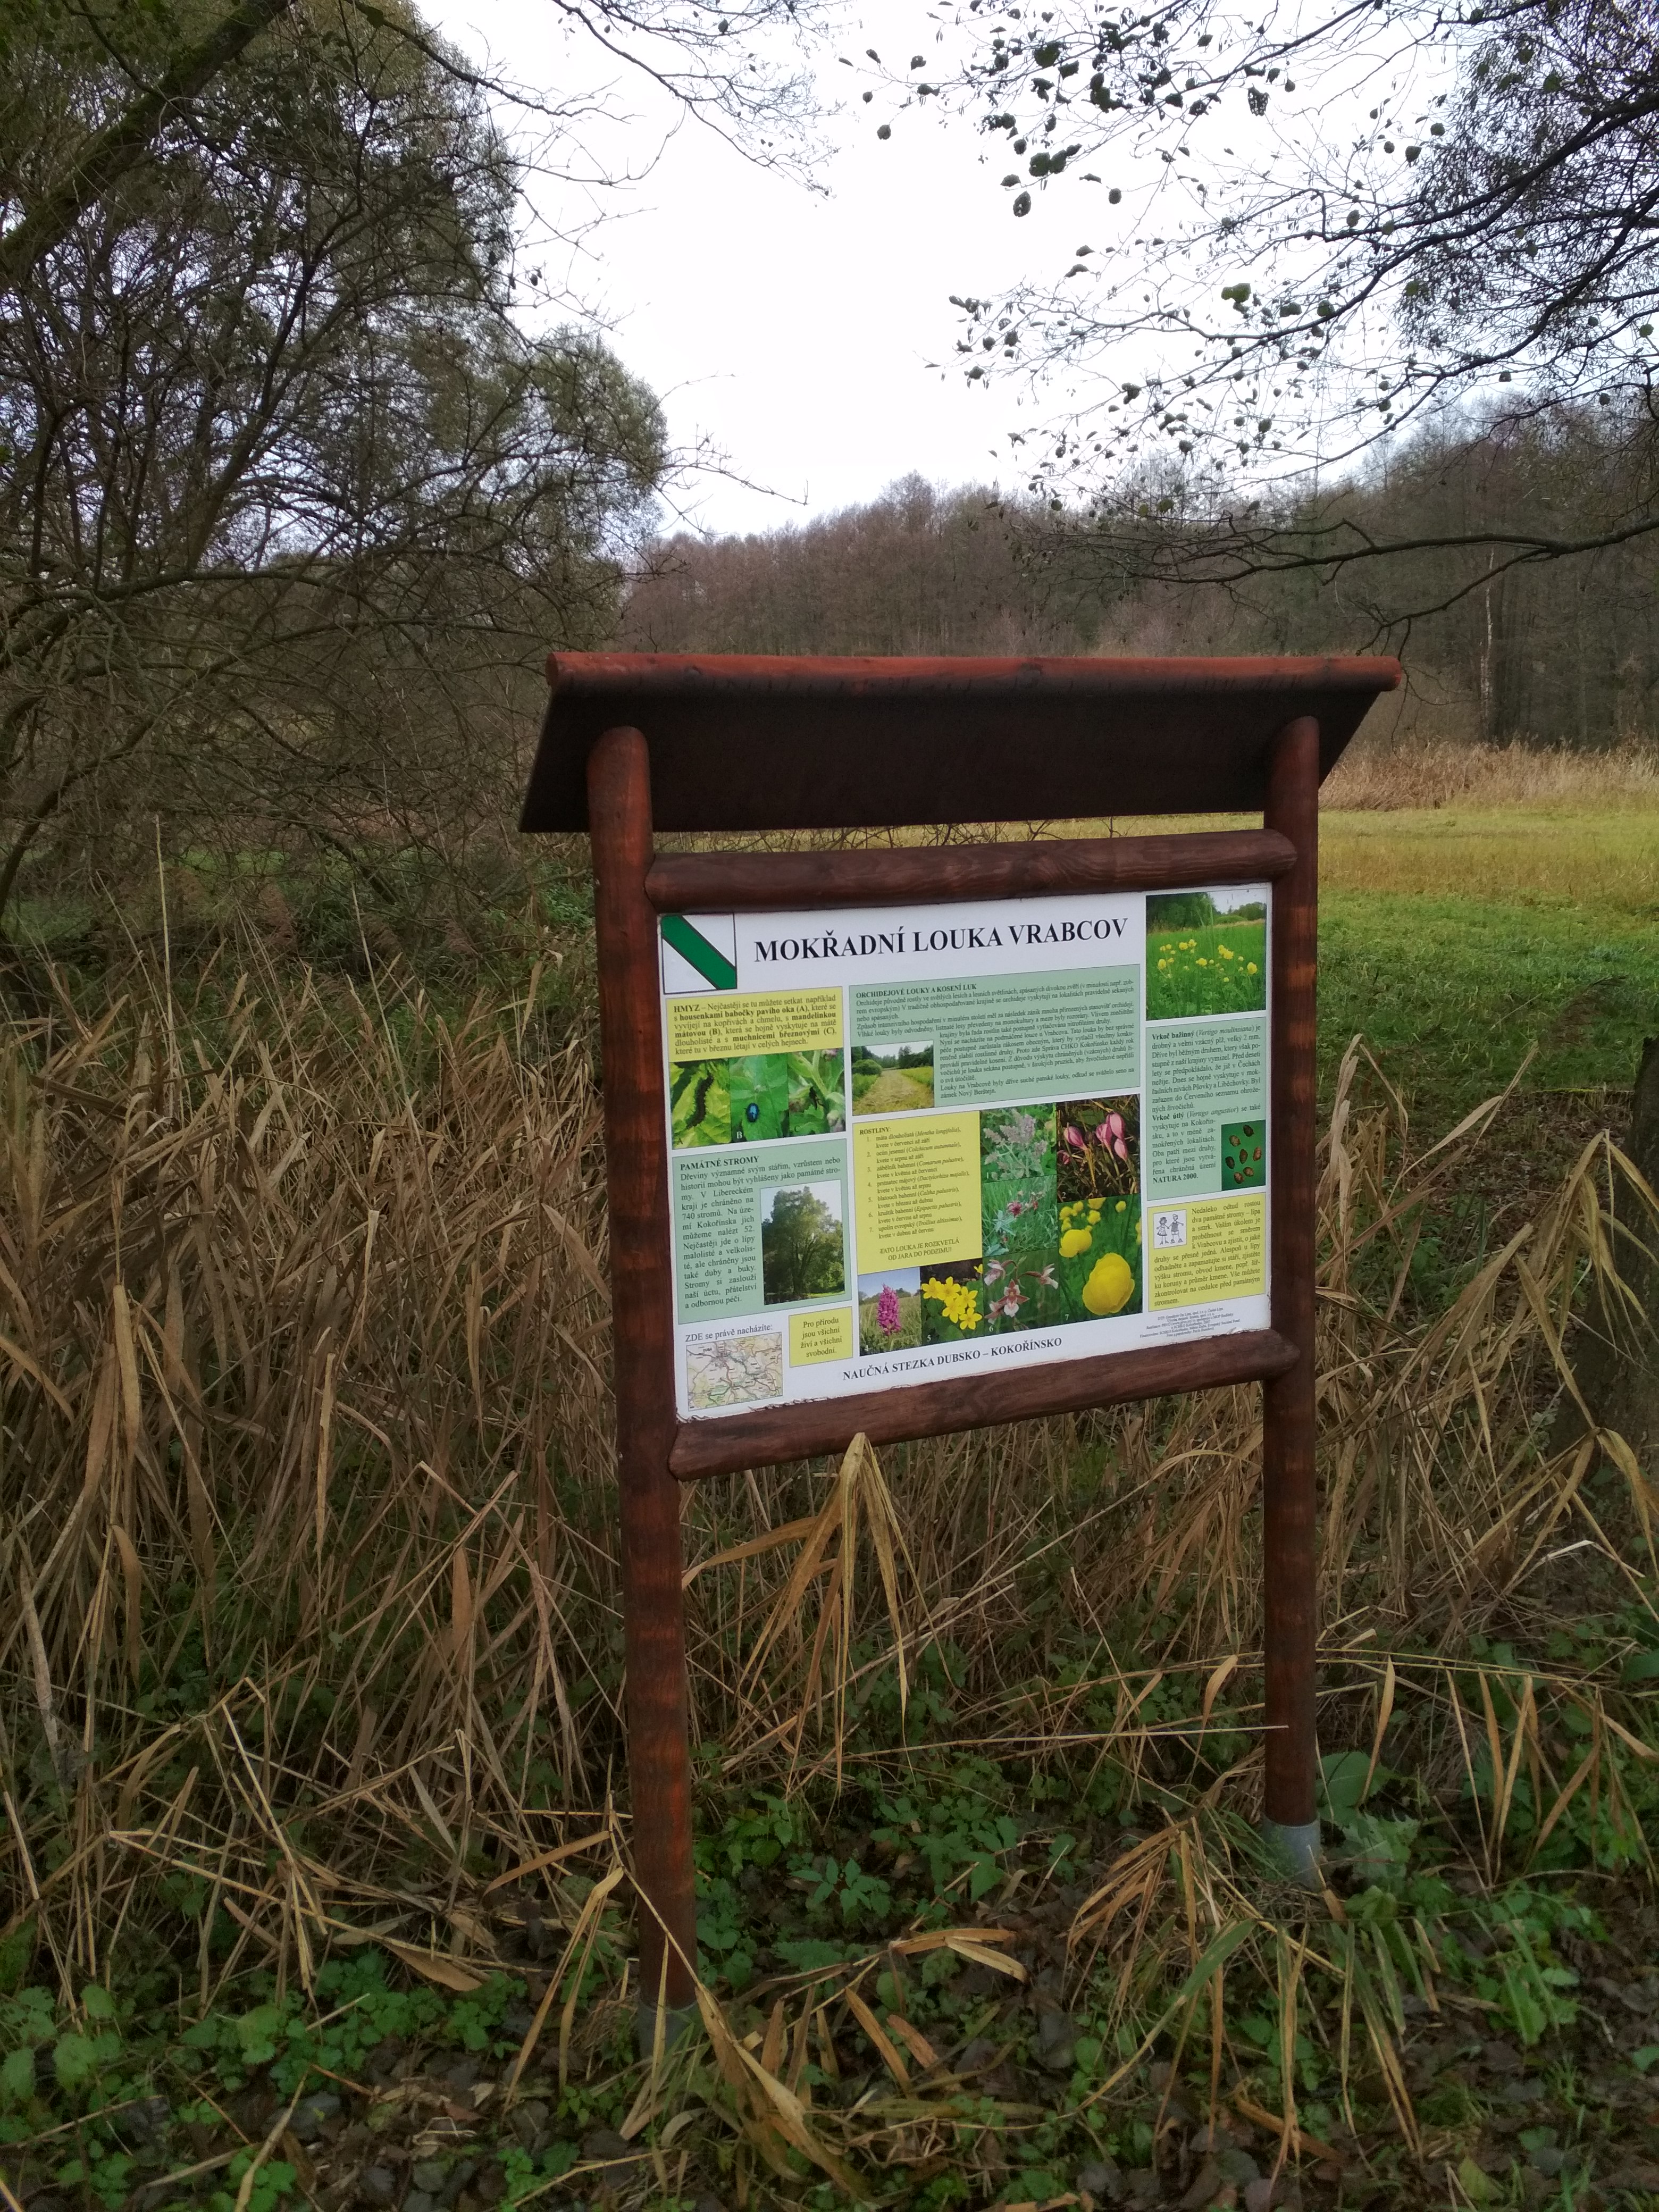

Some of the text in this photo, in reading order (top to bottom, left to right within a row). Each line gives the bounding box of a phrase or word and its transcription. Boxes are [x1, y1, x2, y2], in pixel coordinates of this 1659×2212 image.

[756, 918, 1127, 961] MOKŘADNÍ LOUKA VRABCOV
[679, 1011, 723, 1020] housenkami
[792, 1012, 836, 1020] mandelinkou
[776, 1022, 807, 1031] vyskytuje
[732, 1032, 775, 1042] muchnicemi
[723, 1156, 759, 1166] STROMY
[781, 1171, 795, 1181] jako
[1153, 1175, 1182, 1184] NATURA
[681, 1202, 697, 1211] kraji
[1192, 1205, 1217, 1214] Nedaleko
[1223, 1202, 1238, 1210] odtud
[742, 1215, 754, 1225] jich
[720, 1238, 731, 1247] jde
[923, 1246, 952, 1255] PODZIMU!
[742, 1255, 756, 1264] jsou
[691, 1299, 724, 1308] odbornou
[685, 1333, 703, 1342] ZDE
[802, 1331, 816, 1339] jsou
[892, 1358, 934, 1372] STEZKA
[937, 1351, 980, 1364] DUBSKO
